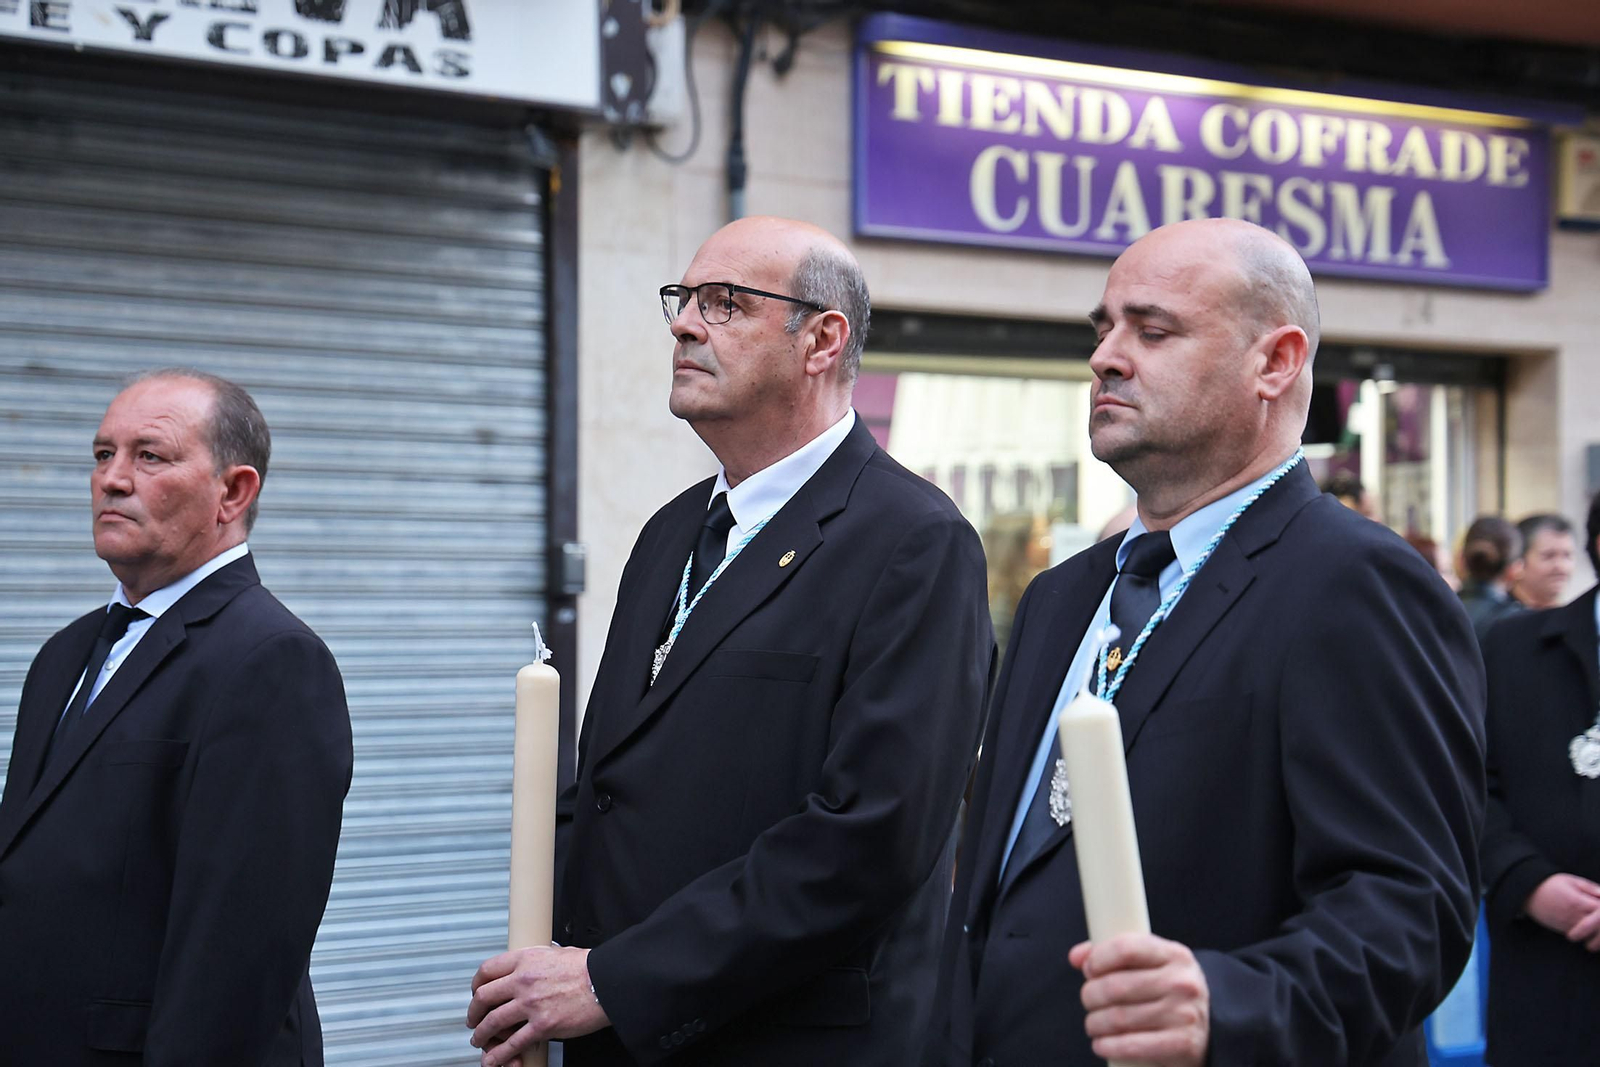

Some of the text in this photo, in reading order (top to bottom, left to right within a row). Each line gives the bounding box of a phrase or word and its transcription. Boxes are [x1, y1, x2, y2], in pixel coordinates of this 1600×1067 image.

[114, 5, 170, 41] Y
[206, 21, 471, 78] COPAS
[877, 62, 1530, 188] TIENDA COFRADE
[969, 146, 1450, 269] CUARESMA
